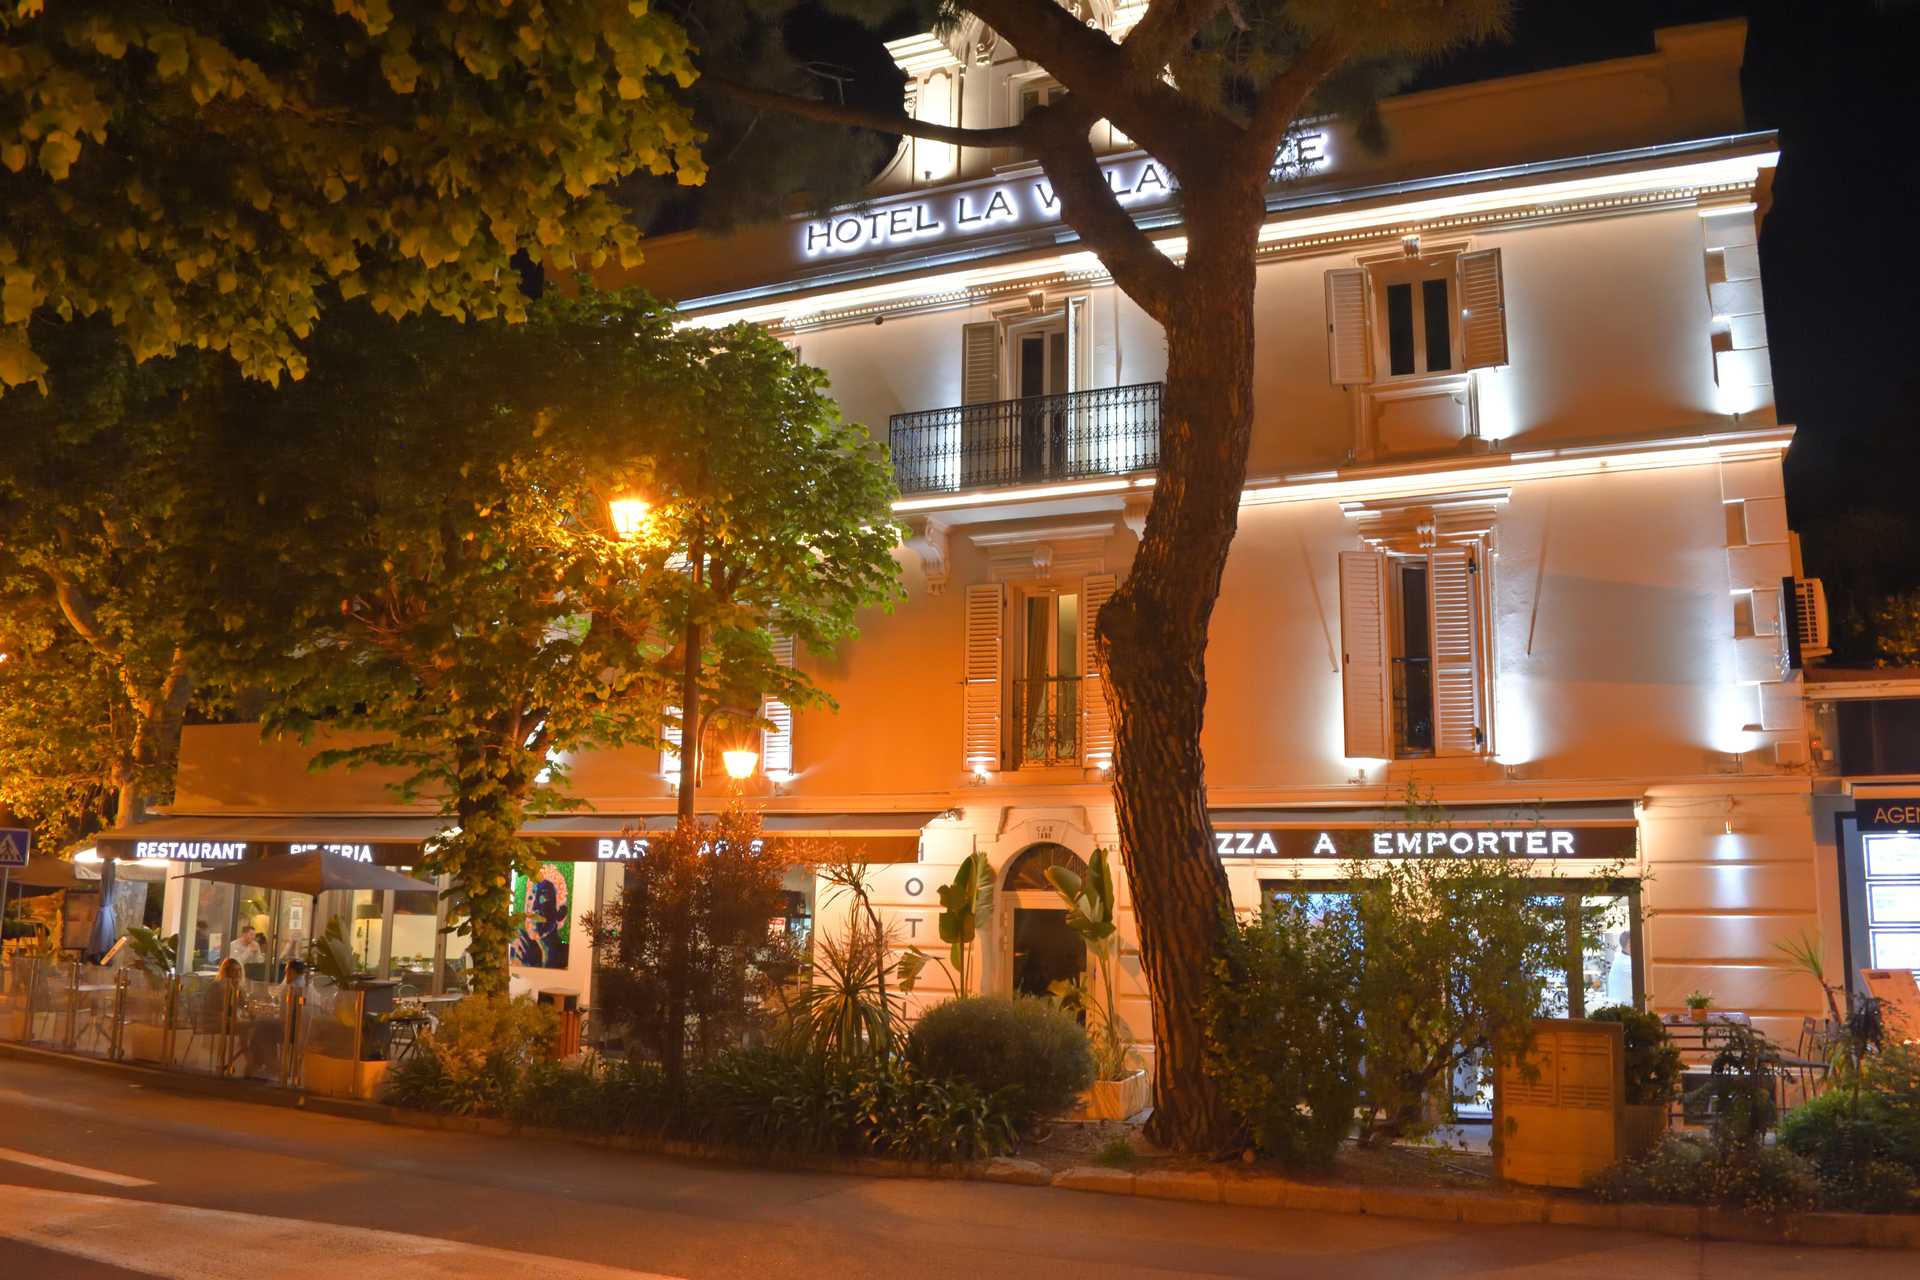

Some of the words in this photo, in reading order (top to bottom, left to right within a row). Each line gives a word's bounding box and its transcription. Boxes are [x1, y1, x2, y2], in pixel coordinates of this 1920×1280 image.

[807, 204, 939, 251] HOTEL
[958, 191, 1012, 225] LA
[1035, 163, 1167, 208] VLA
[1874, 807, 1920, 824] AGE
[136, 841, 247, 861] RESTAURANT
[1215, 831, 1278, 855] ZZA
[1313, 831, 1337, 855] A
[1372, 830, 1576, 855] EMPORTER
